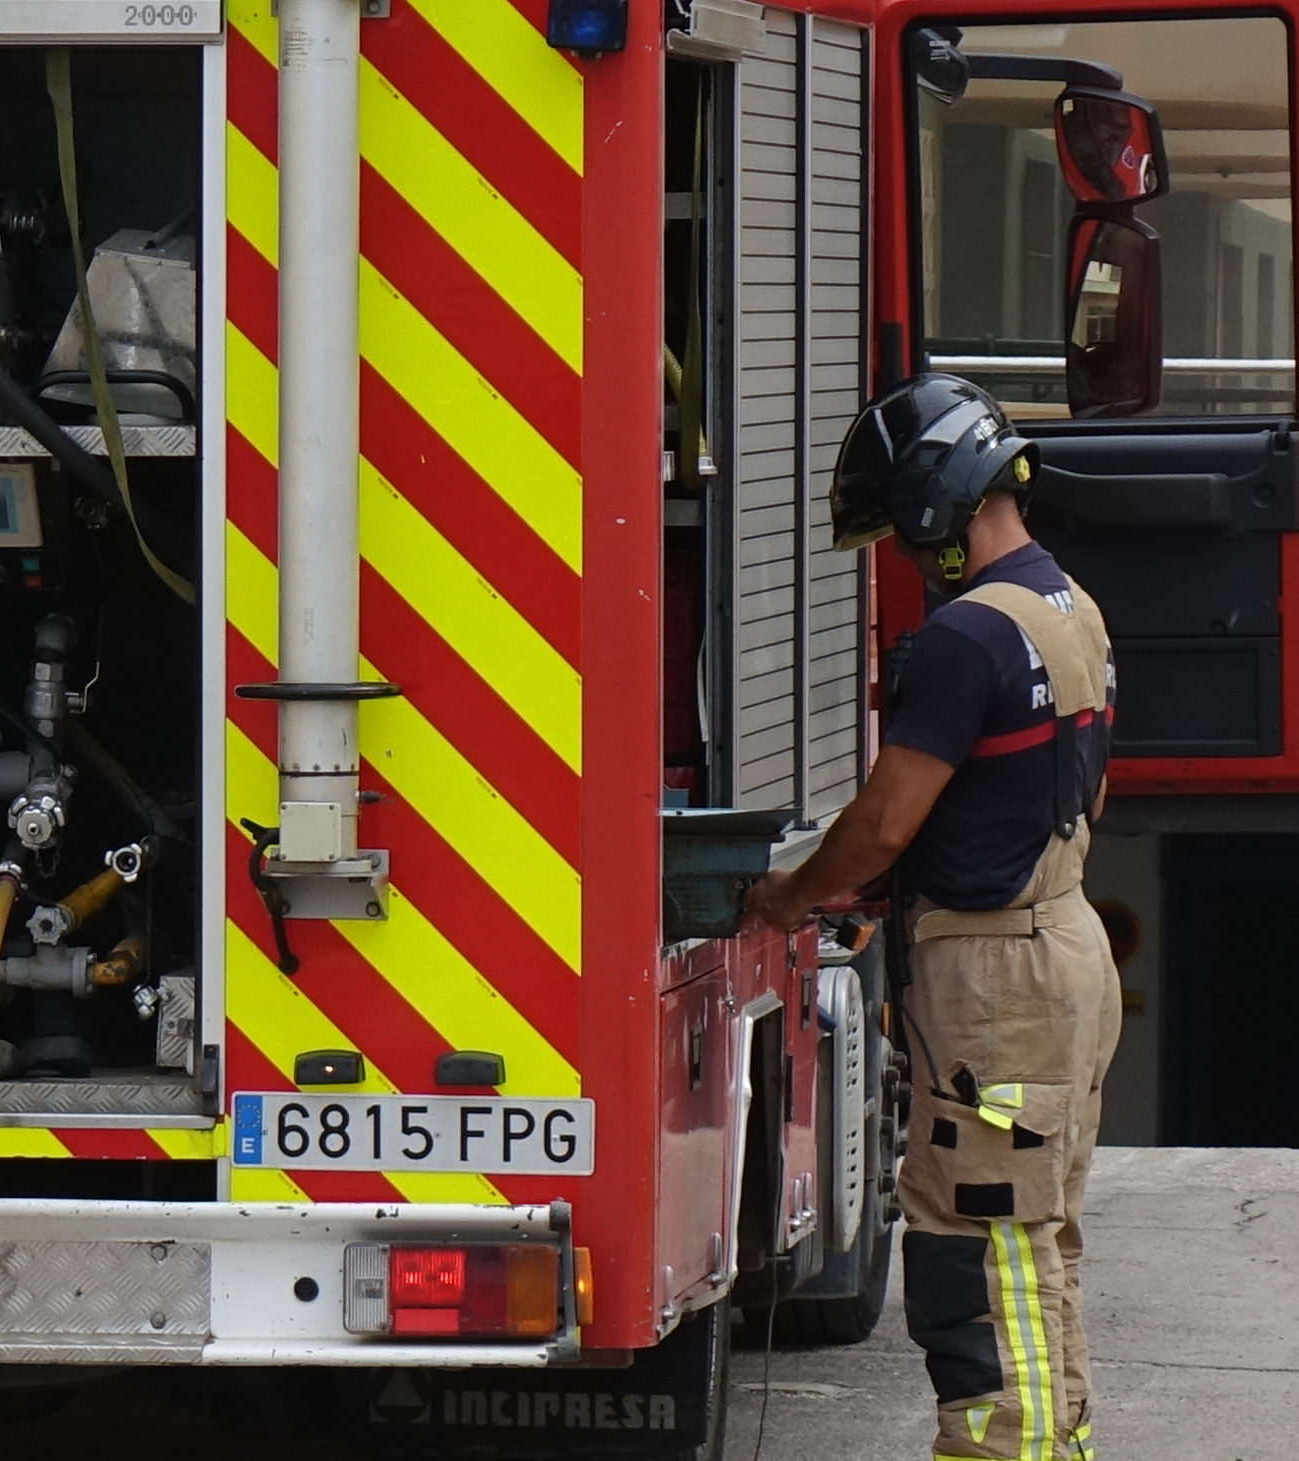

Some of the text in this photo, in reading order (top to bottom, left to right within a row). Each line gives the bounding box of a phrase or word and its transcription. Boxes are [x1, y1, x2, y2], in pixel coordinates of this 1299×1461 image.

[125, 5, 194, 26] 2000
[242, 1138, 254, 1154] E
[277, 1103, 577, 1163] 6815 FPG
[443, 1390, 676, 1430] INCIPRESA
